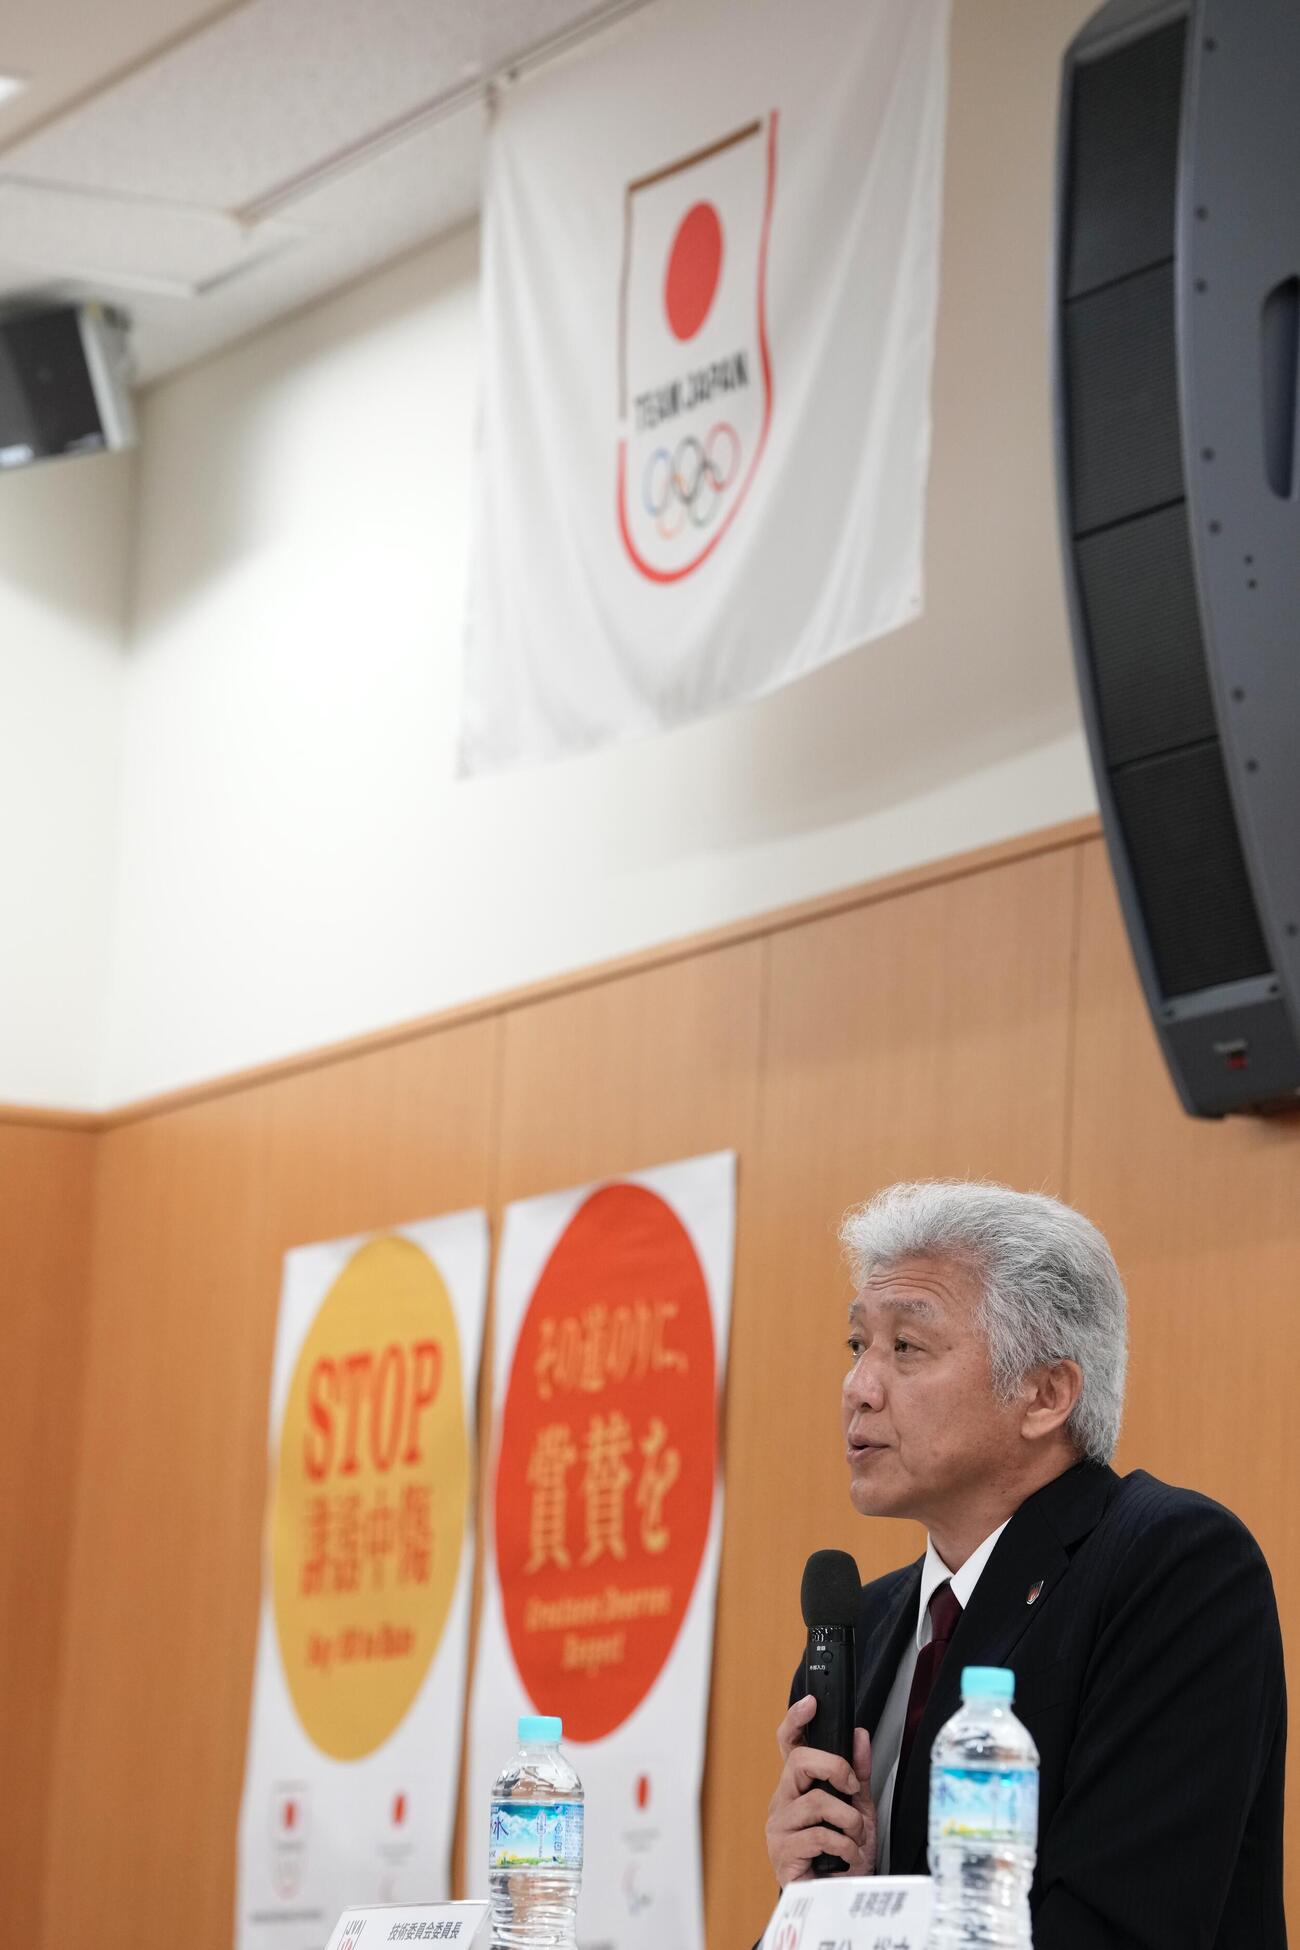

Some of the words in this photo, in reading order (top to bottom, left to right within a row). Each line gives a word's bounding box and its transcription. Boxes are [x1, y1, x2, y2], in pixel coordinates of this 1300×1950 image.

[634, 381, 682, 433] TEAM
[686, 350, 750, 411] JAPAN
[304, 1338, 442, 1483] STOP
[387, 1920, 463, 1942] 技術委員会委員長
